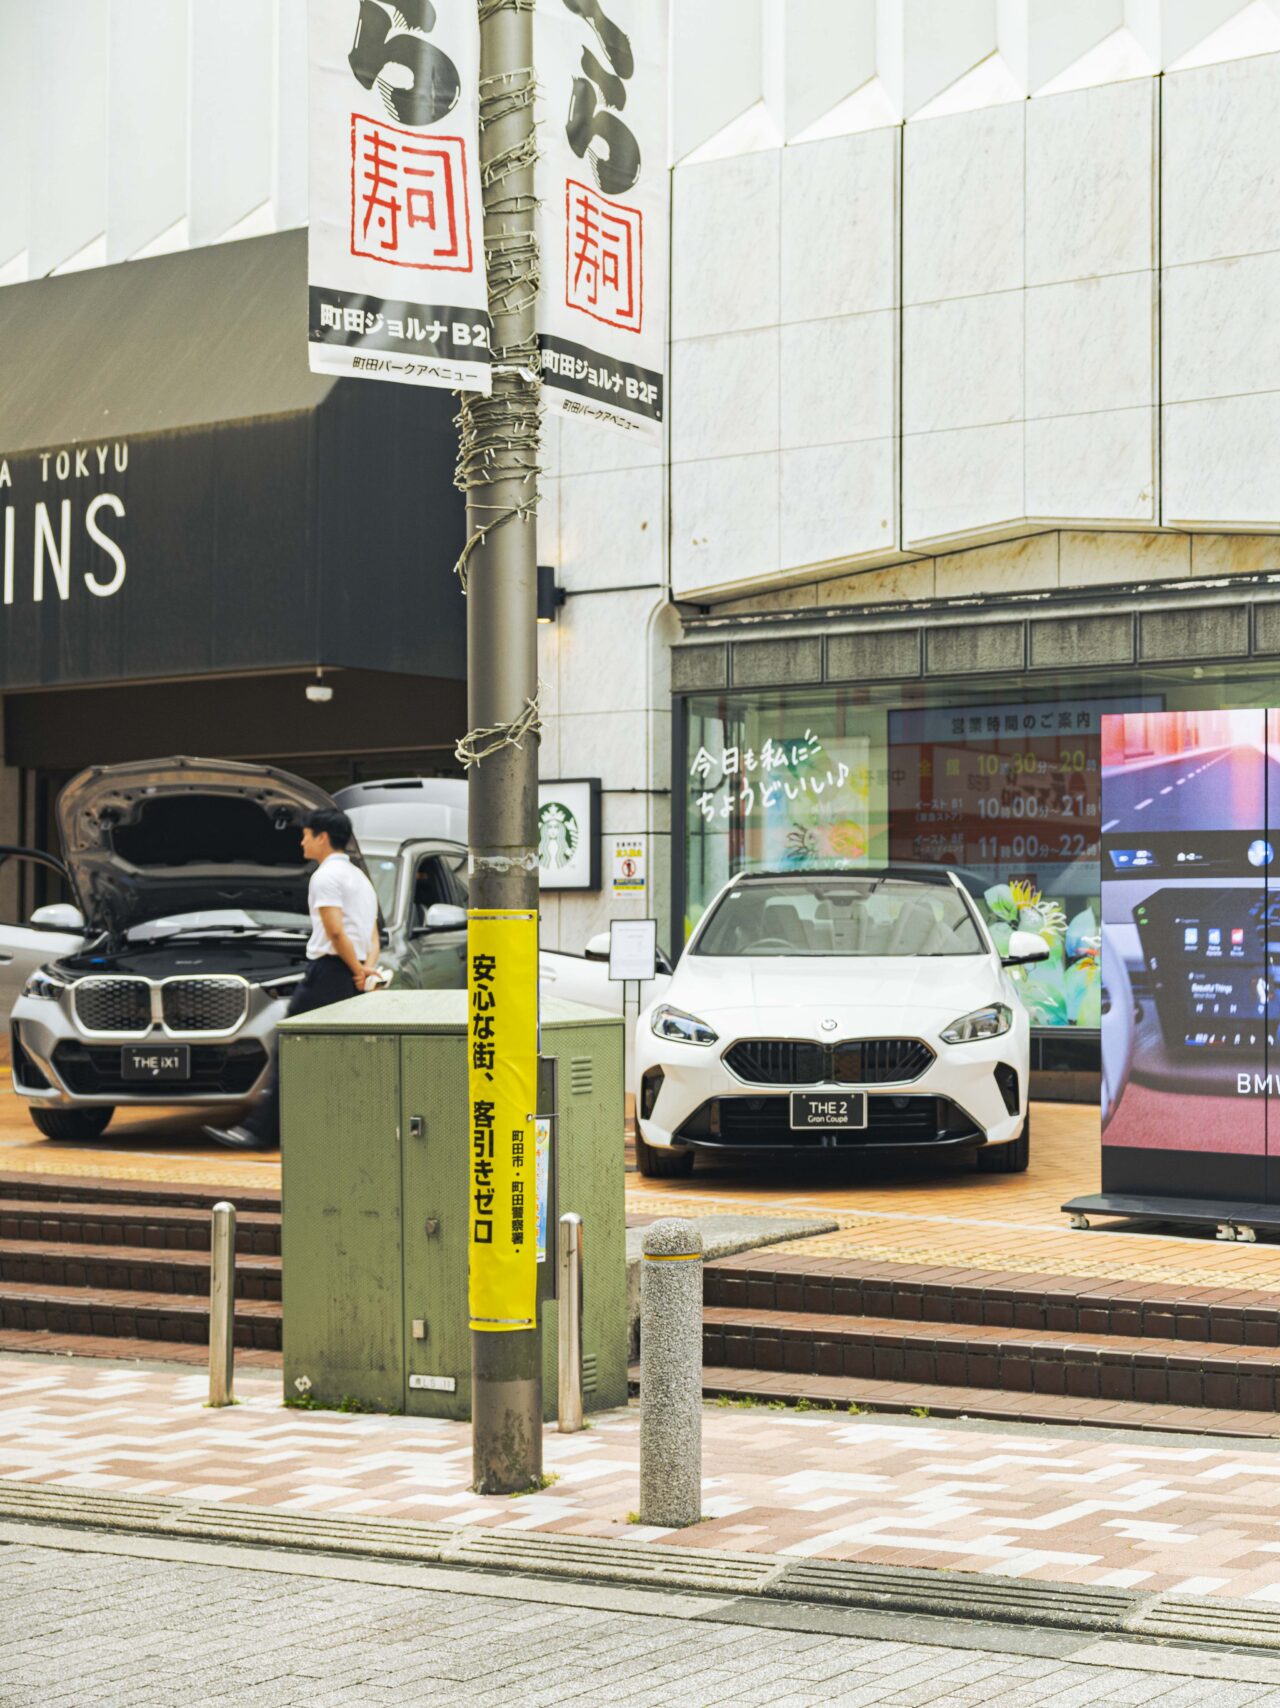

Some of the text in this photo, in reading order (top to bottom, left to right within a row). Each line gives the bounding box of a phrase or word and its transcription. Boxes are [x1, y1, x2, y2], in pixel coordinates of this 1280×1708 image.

[320, 303, 448, 343] 町田ジョルナ
[352, 356, 478, 382] 町田パークアベニュー
[541, 348, 658, 405] 町田ジョルナ B2F
[562, 398, 640, 430] 町田パークアベニュー
[39, 442, 129, 483] TOKYU
[952, 711, 1091, 735] 営業時間のご案内
[690, 738, 809, 778] 今日も私に
[133, 1056, 159, 1068] THE
[472, 953, 497, 1245] 安心な街、 客引きゼロ
[808, 1101, 848, 1114] THE 2
